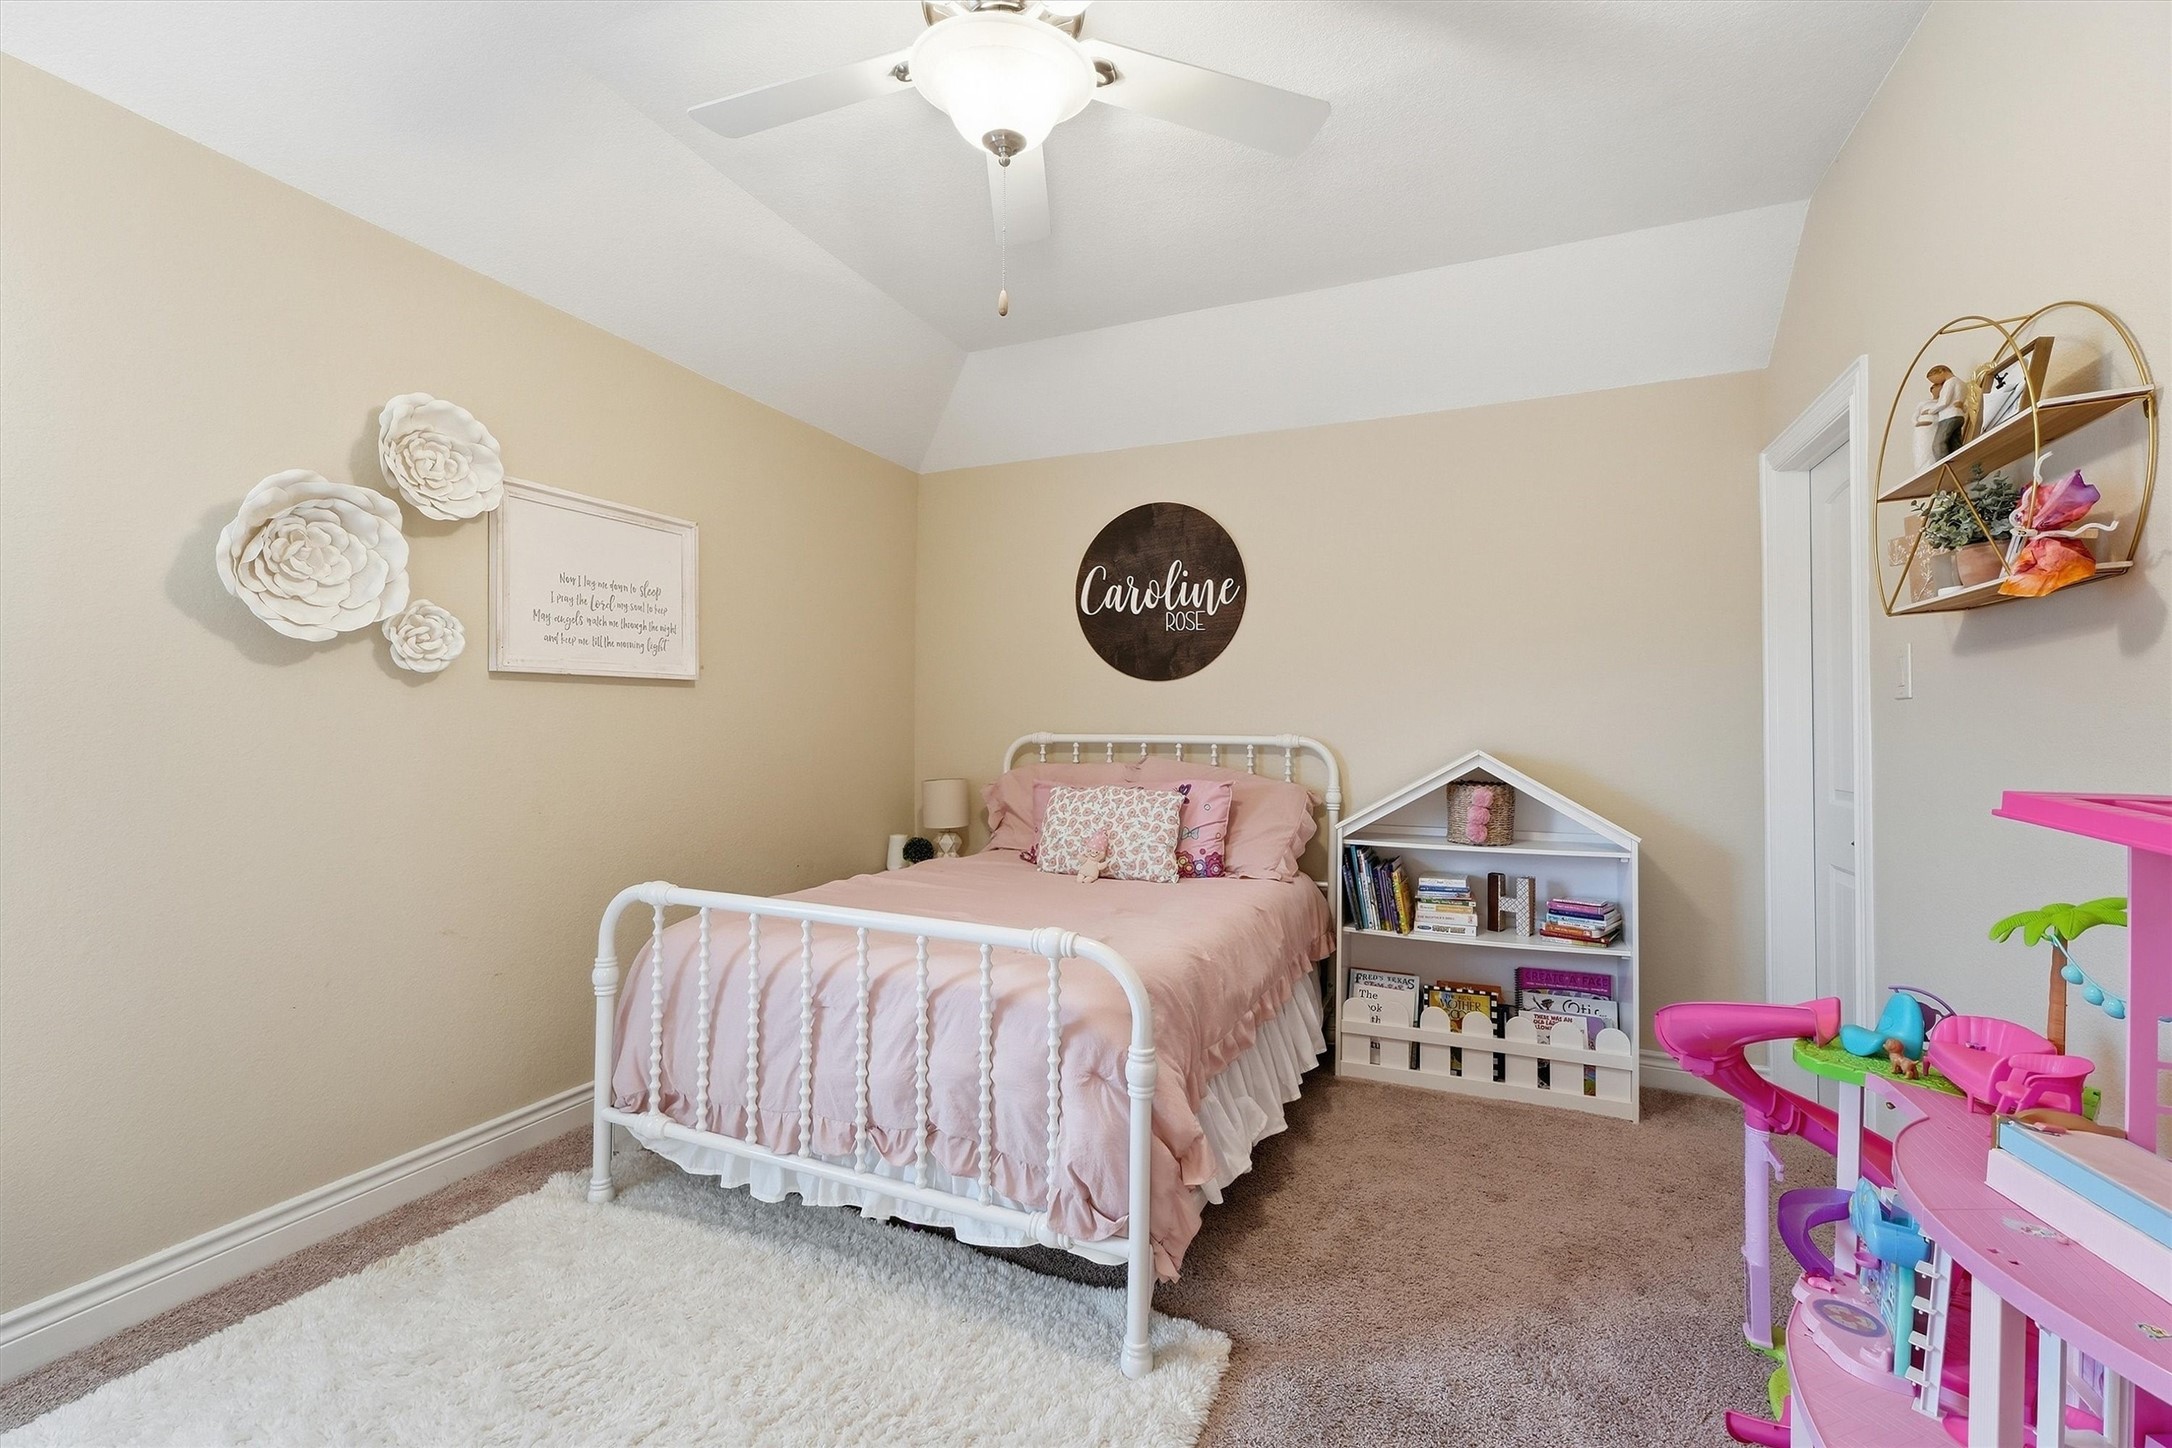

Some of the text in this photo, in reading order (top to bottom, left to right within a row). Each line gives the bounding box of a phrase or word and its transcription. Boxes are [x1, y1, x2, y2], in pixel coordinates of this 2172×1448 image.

[559, 572, 662, 600] Now I lay me down to sleep
[1080, 560, 1240, 616] Caroline
[550, 591, 668, 616] I pray the Lord my soul to keep
[532, 608, 677, 637] May angels watch me through the night
[1165, 610, 1206, 631] ROSE
[544, 632, 670, 656] and keep me till the morning light
[1359, 989, 1378, 999] The
[1387, 976, 1415, 990] TEXAS
[1440, 998, 1481, 1013] MOTHER
